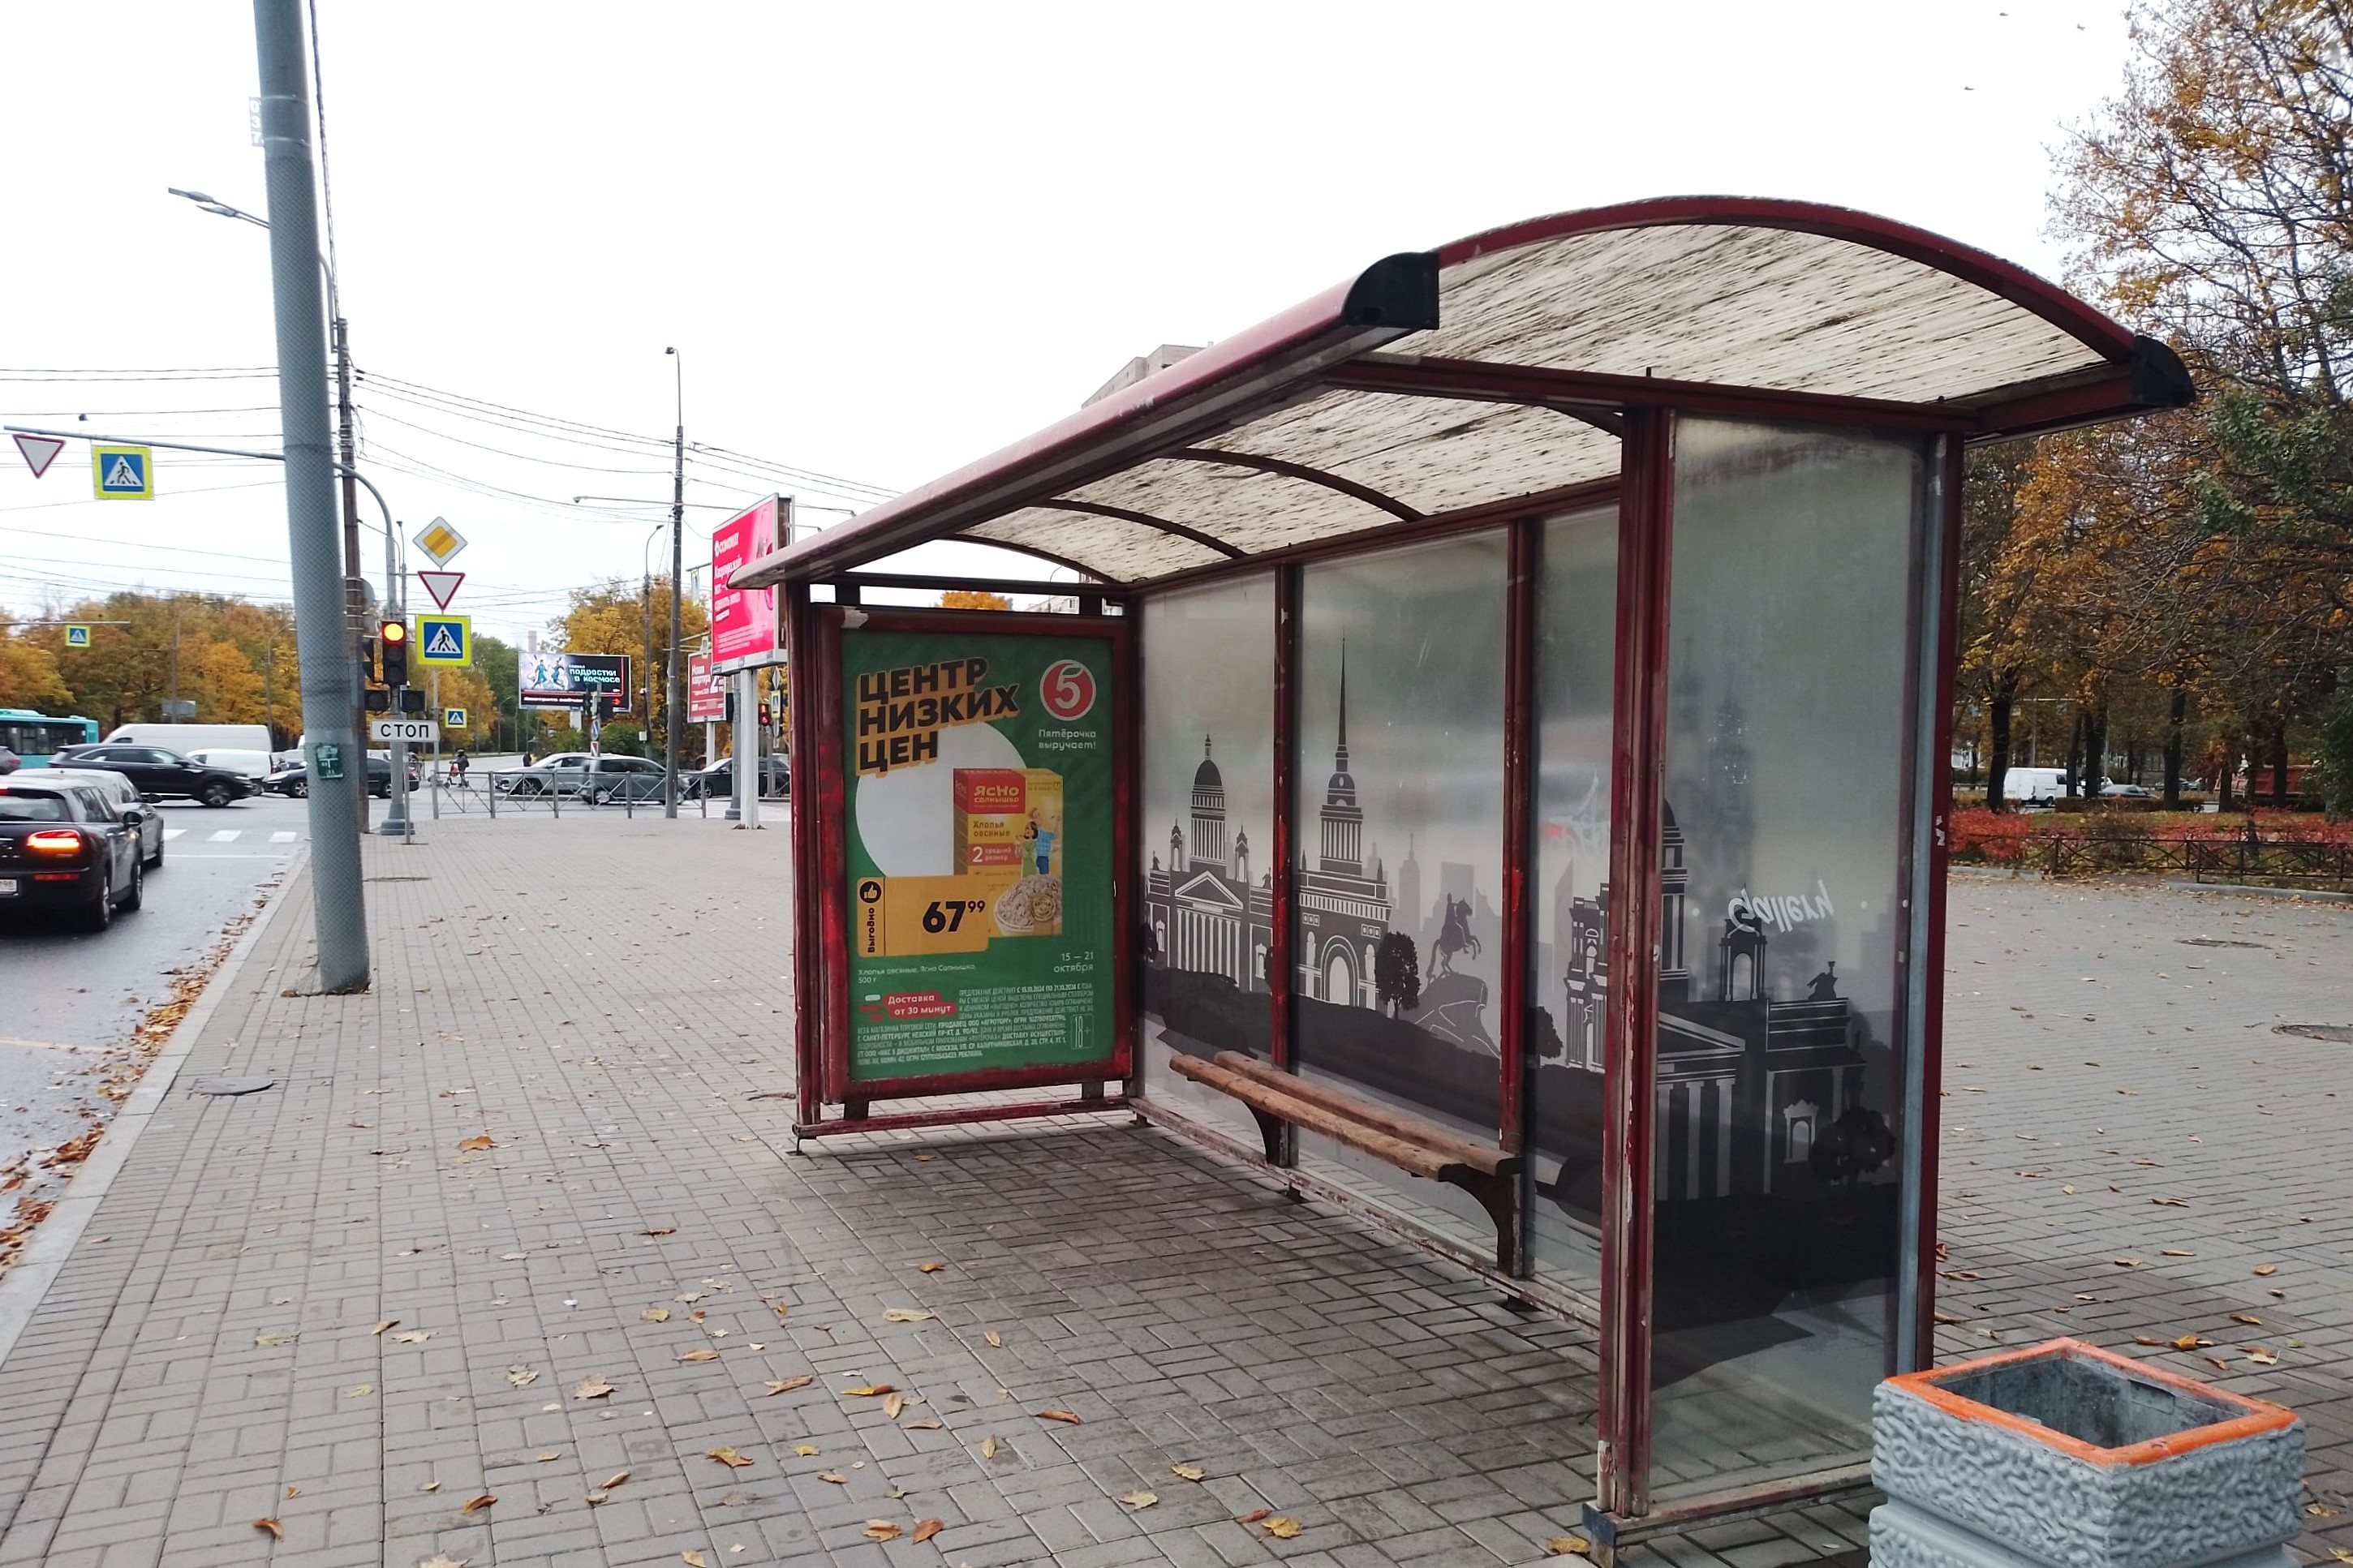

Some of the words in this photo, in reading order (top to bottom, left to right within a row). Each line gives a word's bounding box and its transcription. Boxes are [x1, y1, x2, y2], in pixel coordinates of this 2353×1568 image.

[860, 658, 987, 703] ЦЕНТР
[860, 685, 1019, 737] НИЗКИХ
[381, 724, 429, 738] СТОП
[1039, 728, 1096, 740] Пятёрочка
[1039, 741, 1096, 750] выручает!
[860, 732, 939, 772] ЦЕН
[974, 820, 1004, 828] Хлопья
[973, 846, 983, 863] 2
[867, 908, 875, 953] Выгодно
[1061, 952, 1071, 961] 15
[1084, 952, 1094, 960] 21
[1054, 962, 1094, 974] октября
[888, 994, 936, 1005] Доставка
[907, 1007, 918, 1015] 30
[921, 1005, 952, 1015] минут
